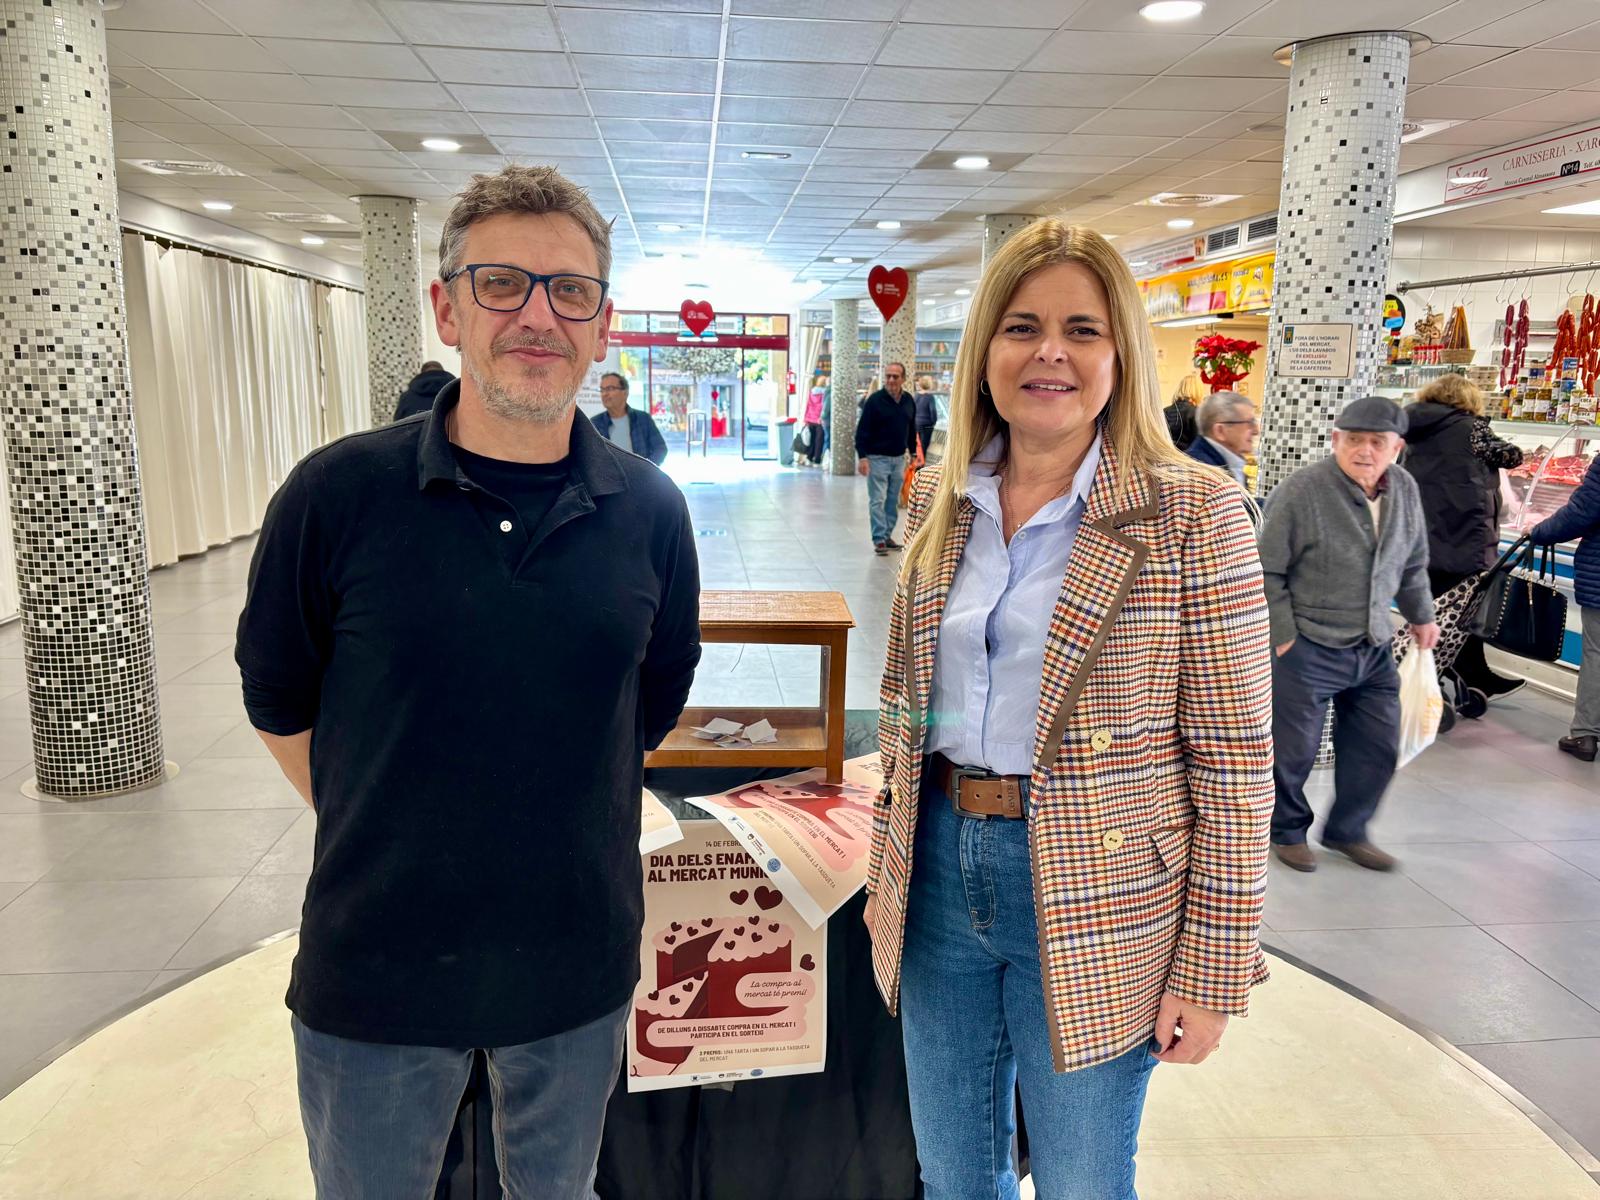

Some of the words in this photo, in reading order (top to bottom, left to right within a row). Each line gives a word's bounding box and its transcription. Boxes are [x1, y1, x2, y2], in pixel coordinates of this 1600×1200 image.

[1502, 144, 1566, 171] CARNISSERIA
[1576, 138, 1600, 153] XAR
[824, 836, 844, 856] MERCAT
[650, 854, 674, 867] DIA
[677, 853, 713, 867] DELS
[647, 869, 666, 882] AL
[669, 867, 727, 882] MERCAT
[762, 980, 793, 989] compra
[793, 979, 802, 987] al
[744, 990, 772, 998] mercat
